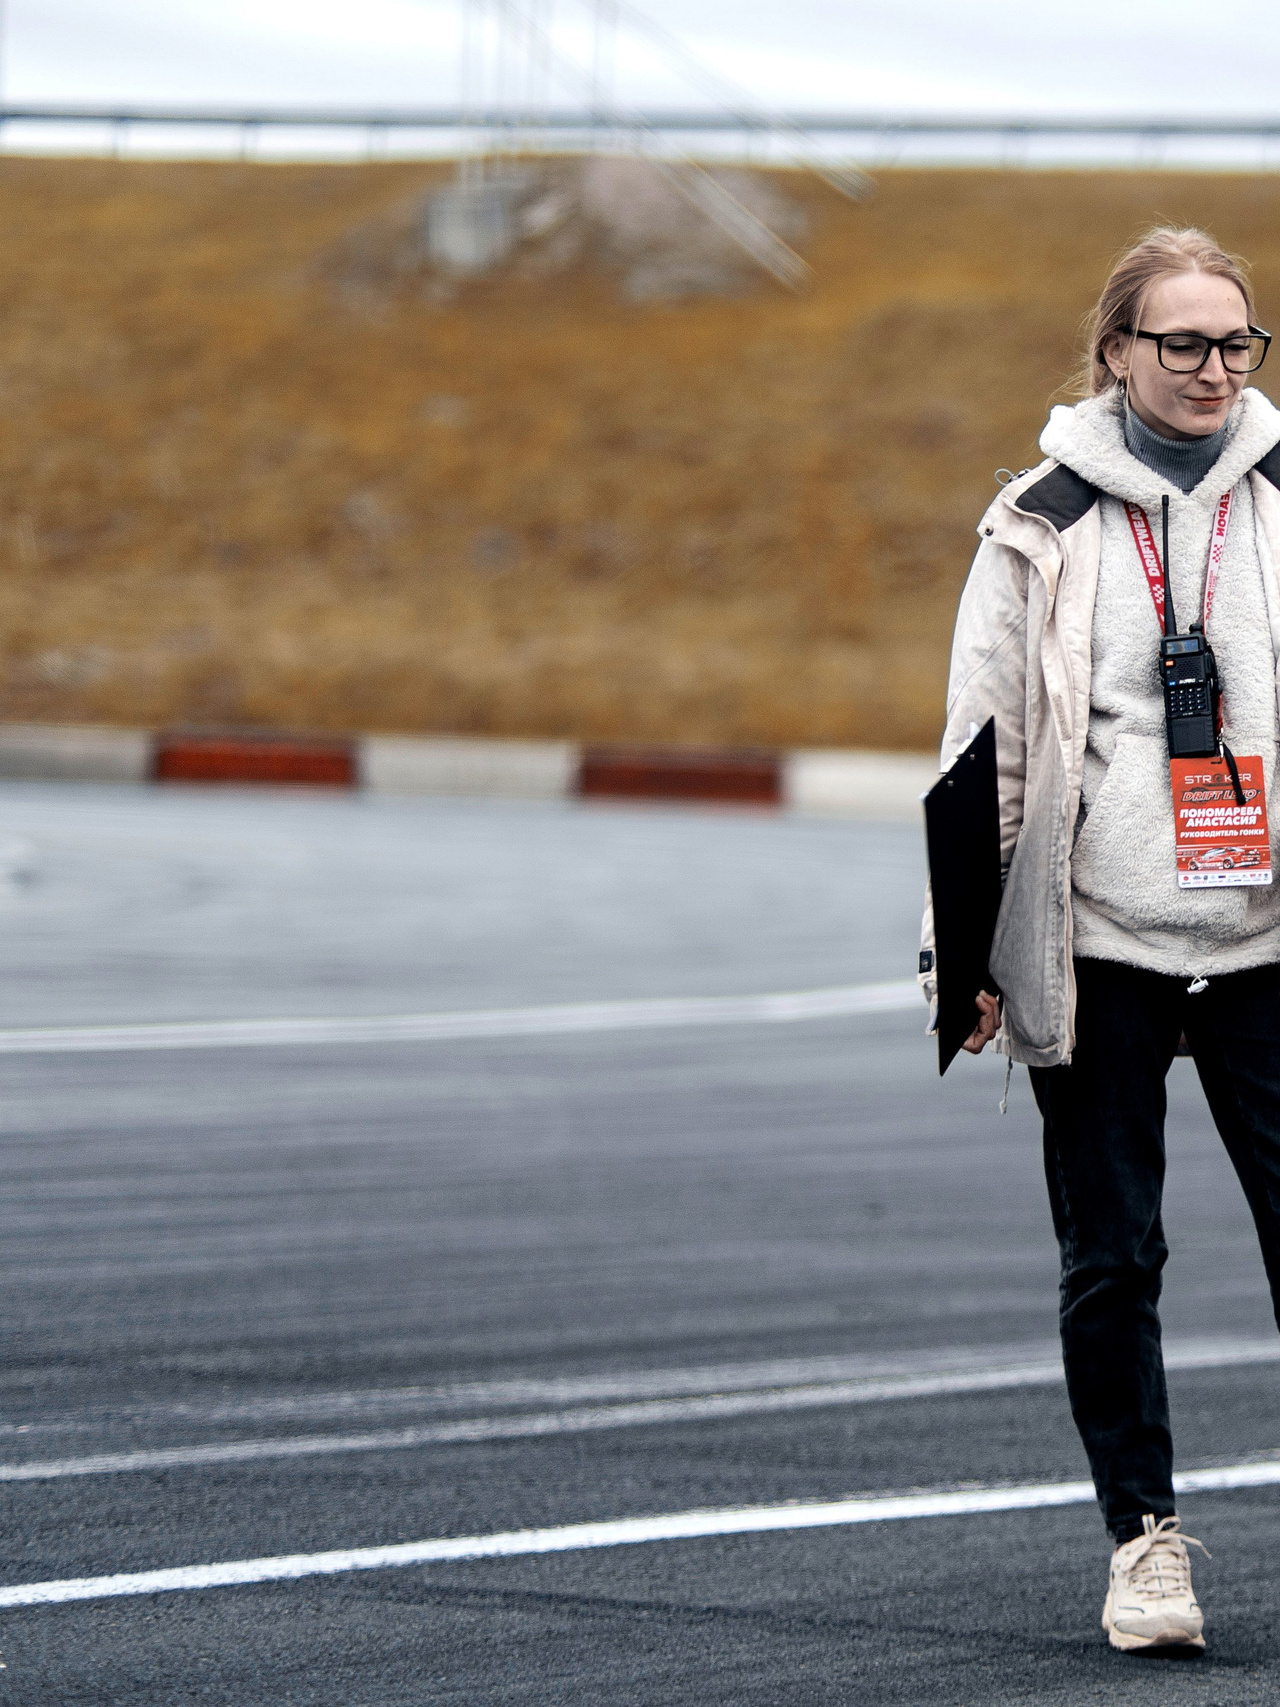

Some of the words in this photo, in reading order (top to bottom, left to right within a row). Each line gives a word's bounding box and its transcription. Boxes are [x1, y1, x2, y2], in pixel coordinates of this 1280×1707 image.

[1182, 790, 1223, 802] DRIFT
[1223, 788, 1258, 801] LEO
[1179, 806, 1263, 819] ПОНОМАРЕВА
[1185, 816, 1257, 828] АНАСТАСИЯ
[1180, 829, 1238, 838] РУКОВОДИТЕЛЬ
[1239, 828, 1265, 836] ГОНКИ
